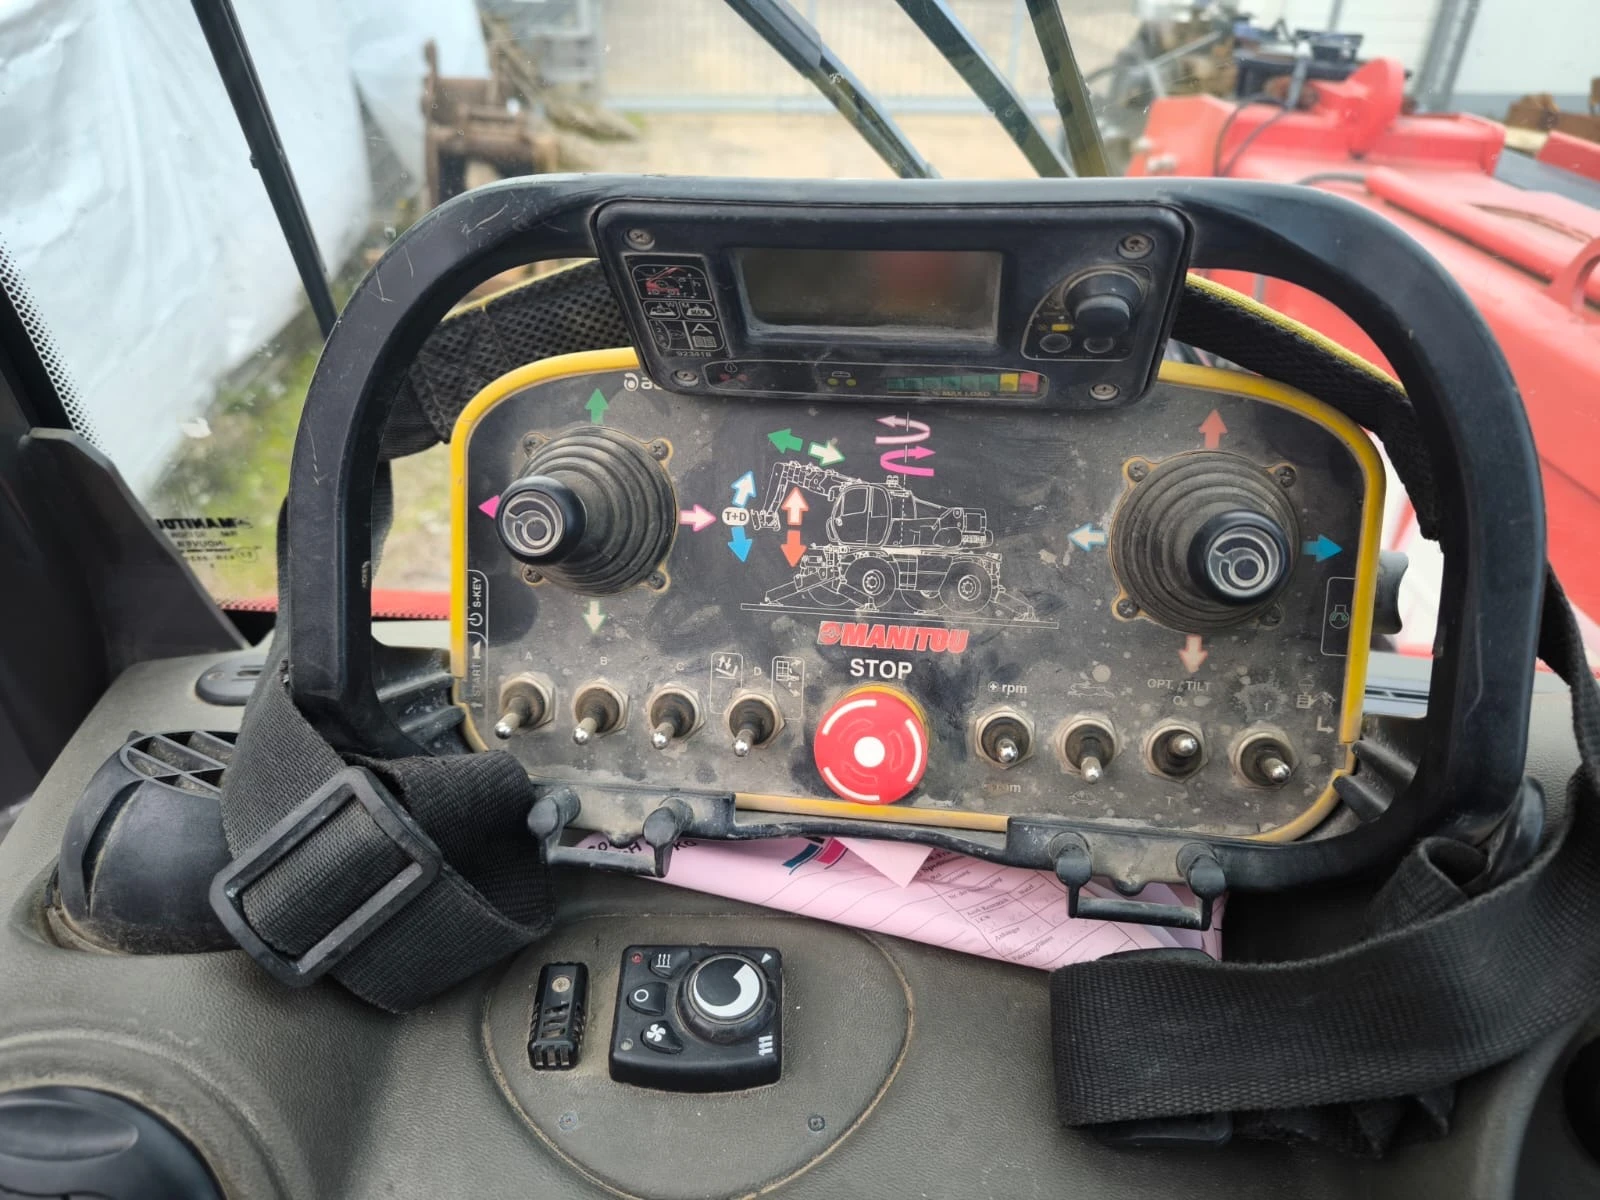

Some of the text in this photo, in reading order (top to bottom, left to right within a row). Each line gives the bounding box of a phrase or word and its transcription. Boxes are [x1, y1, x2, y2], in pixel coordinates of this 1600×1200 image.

[691, 323, 713, 335] A
[725, 511, 747, 523] T+D
[840, 622, 969, 654] MANITOU
[524, 651, 533, 661] A
[599, 656, 608, 666] B
[676, 661, 685, 671] C
[753, 666, 762, 676] D
[849, 658, 913, 680] STOP
[472, 664, 482, 697] START
[1185, 680, 1211, 692] TILT
[1001, 684, 1028, 696] rpm
